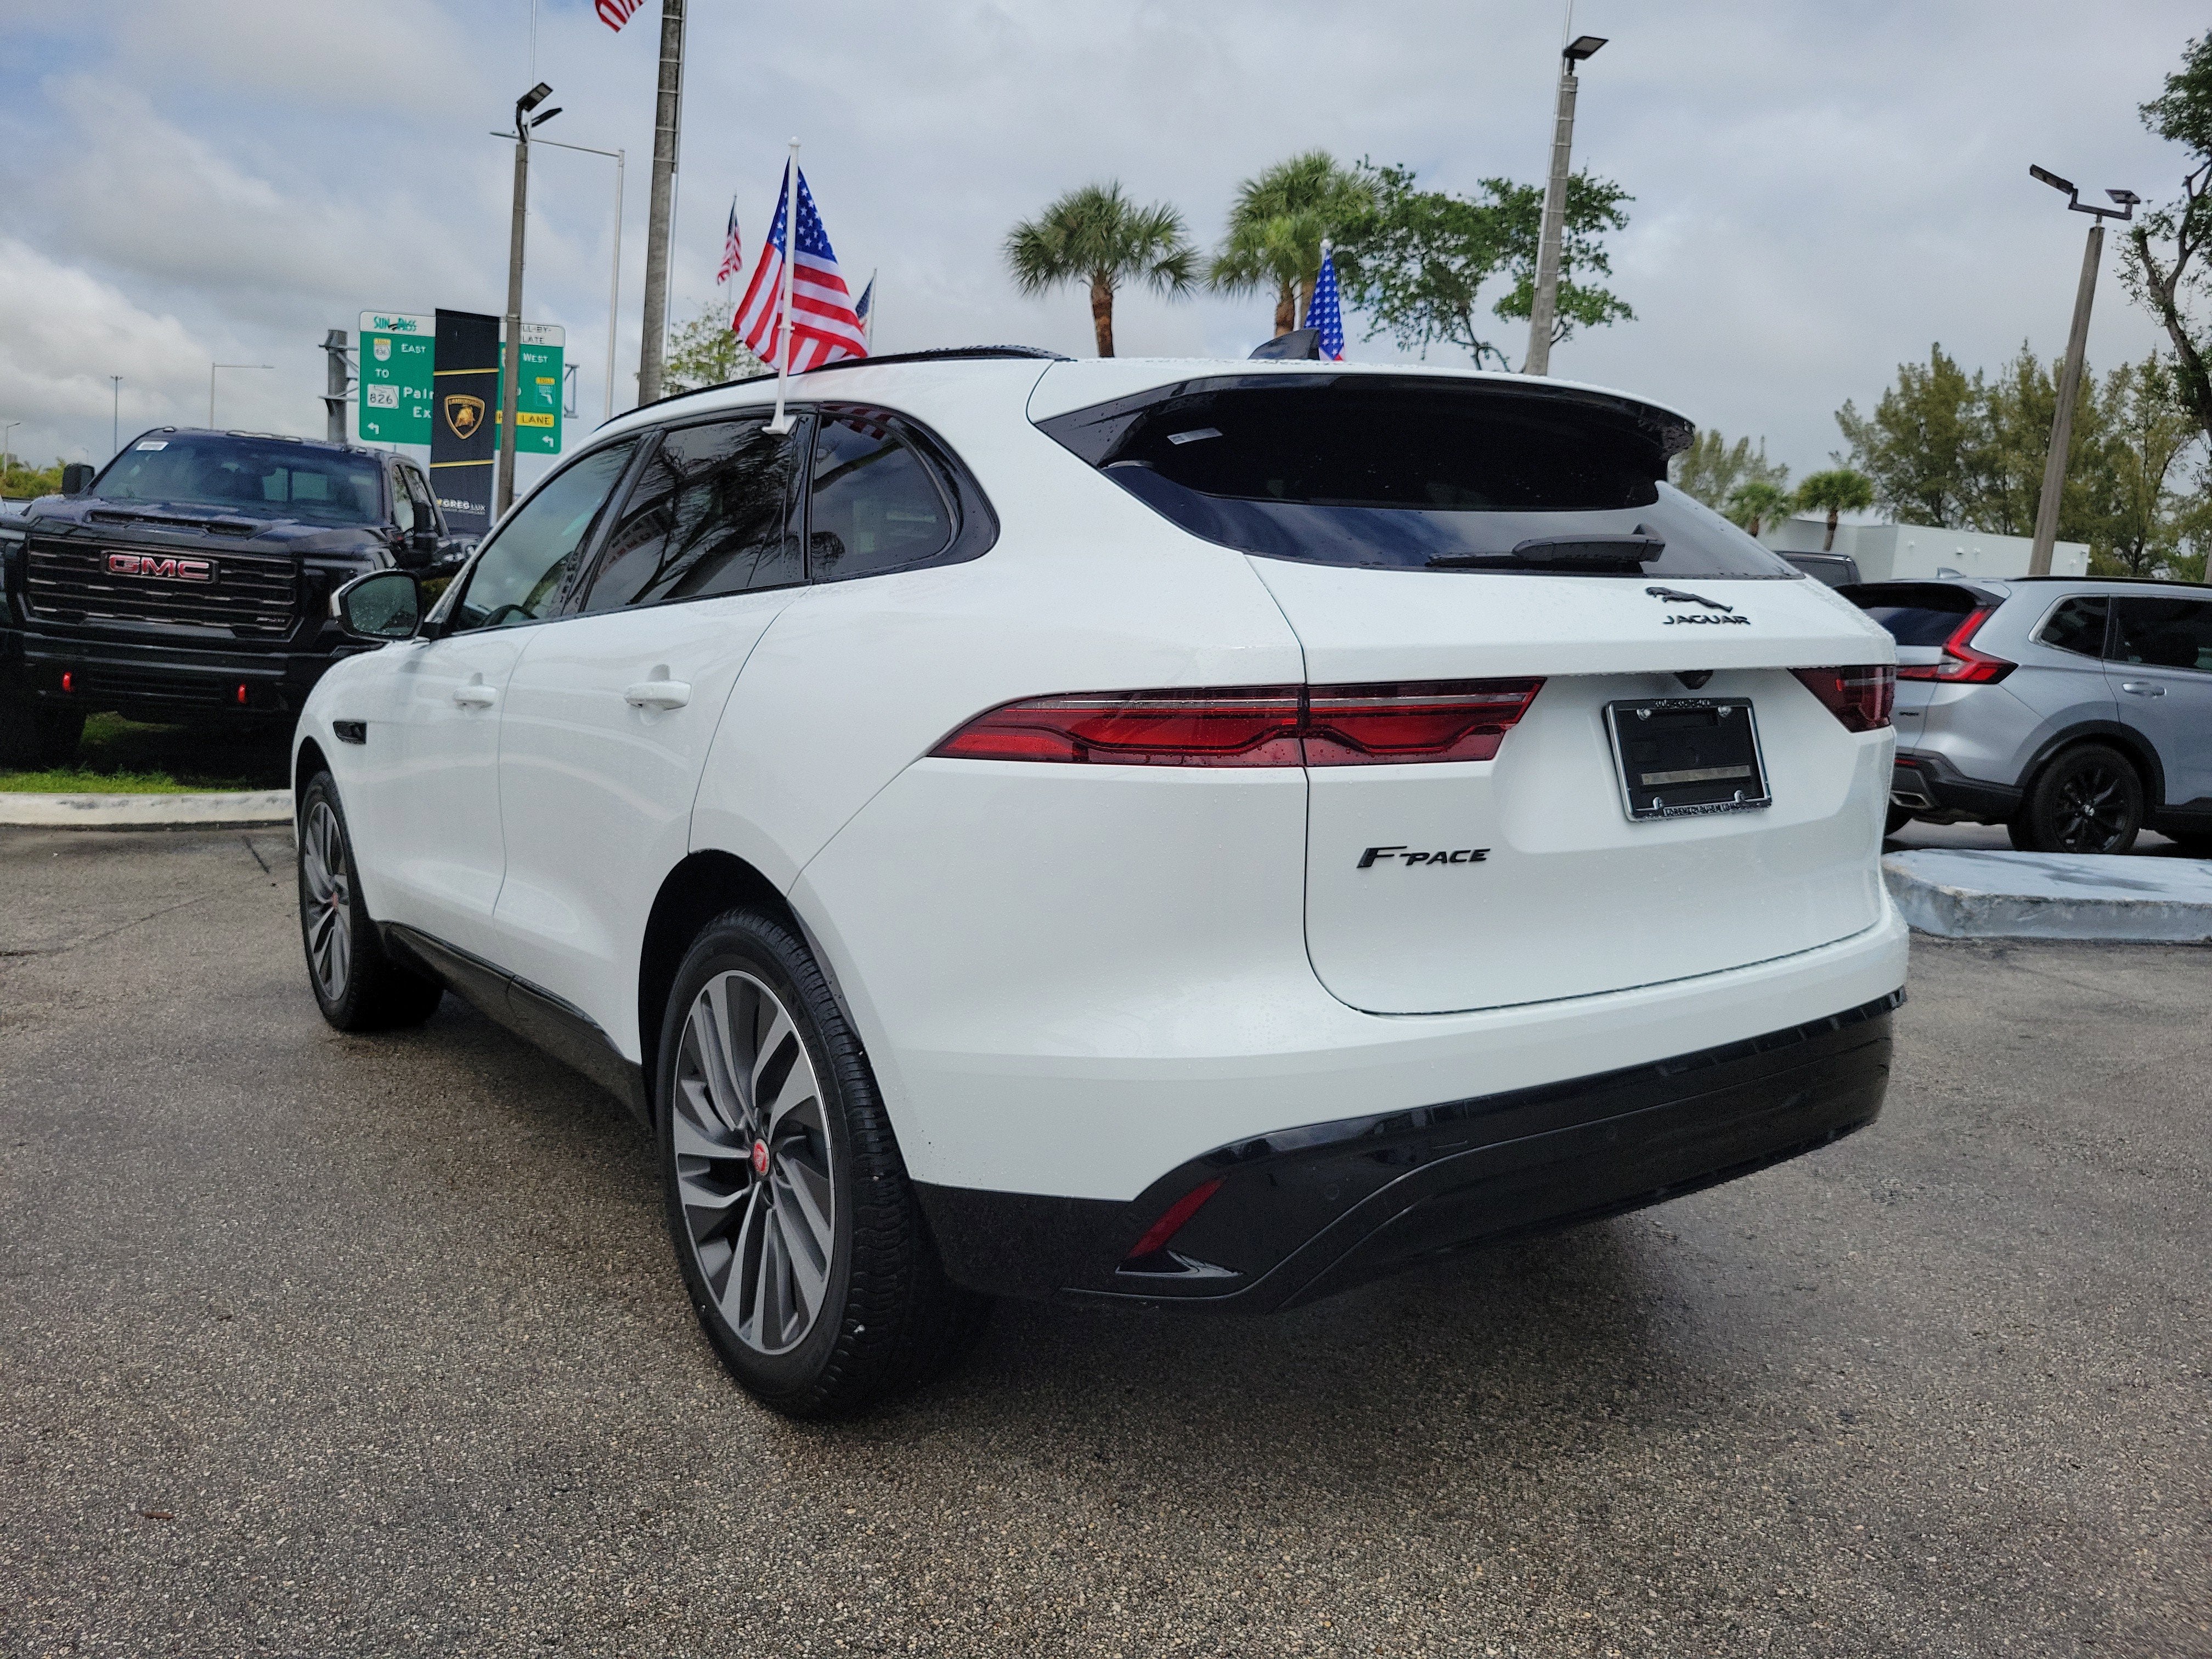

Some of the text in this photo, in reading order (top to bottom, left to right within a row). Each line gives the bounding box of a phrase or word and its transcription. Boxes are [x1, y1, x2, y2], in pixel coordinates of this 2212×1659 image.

[401, 343, 426, 354] EAST
[522, 352, 548, 364] WEST
[375, 368, 390, 378] TO
[369, 393, 393, 404] 826
[413, 406, 431, 418] Ex
[522, 415, 550, 425] LANE
[108, 554, 210, 580] GMC
[1662, 615, 1751, 625] JAGUAR
